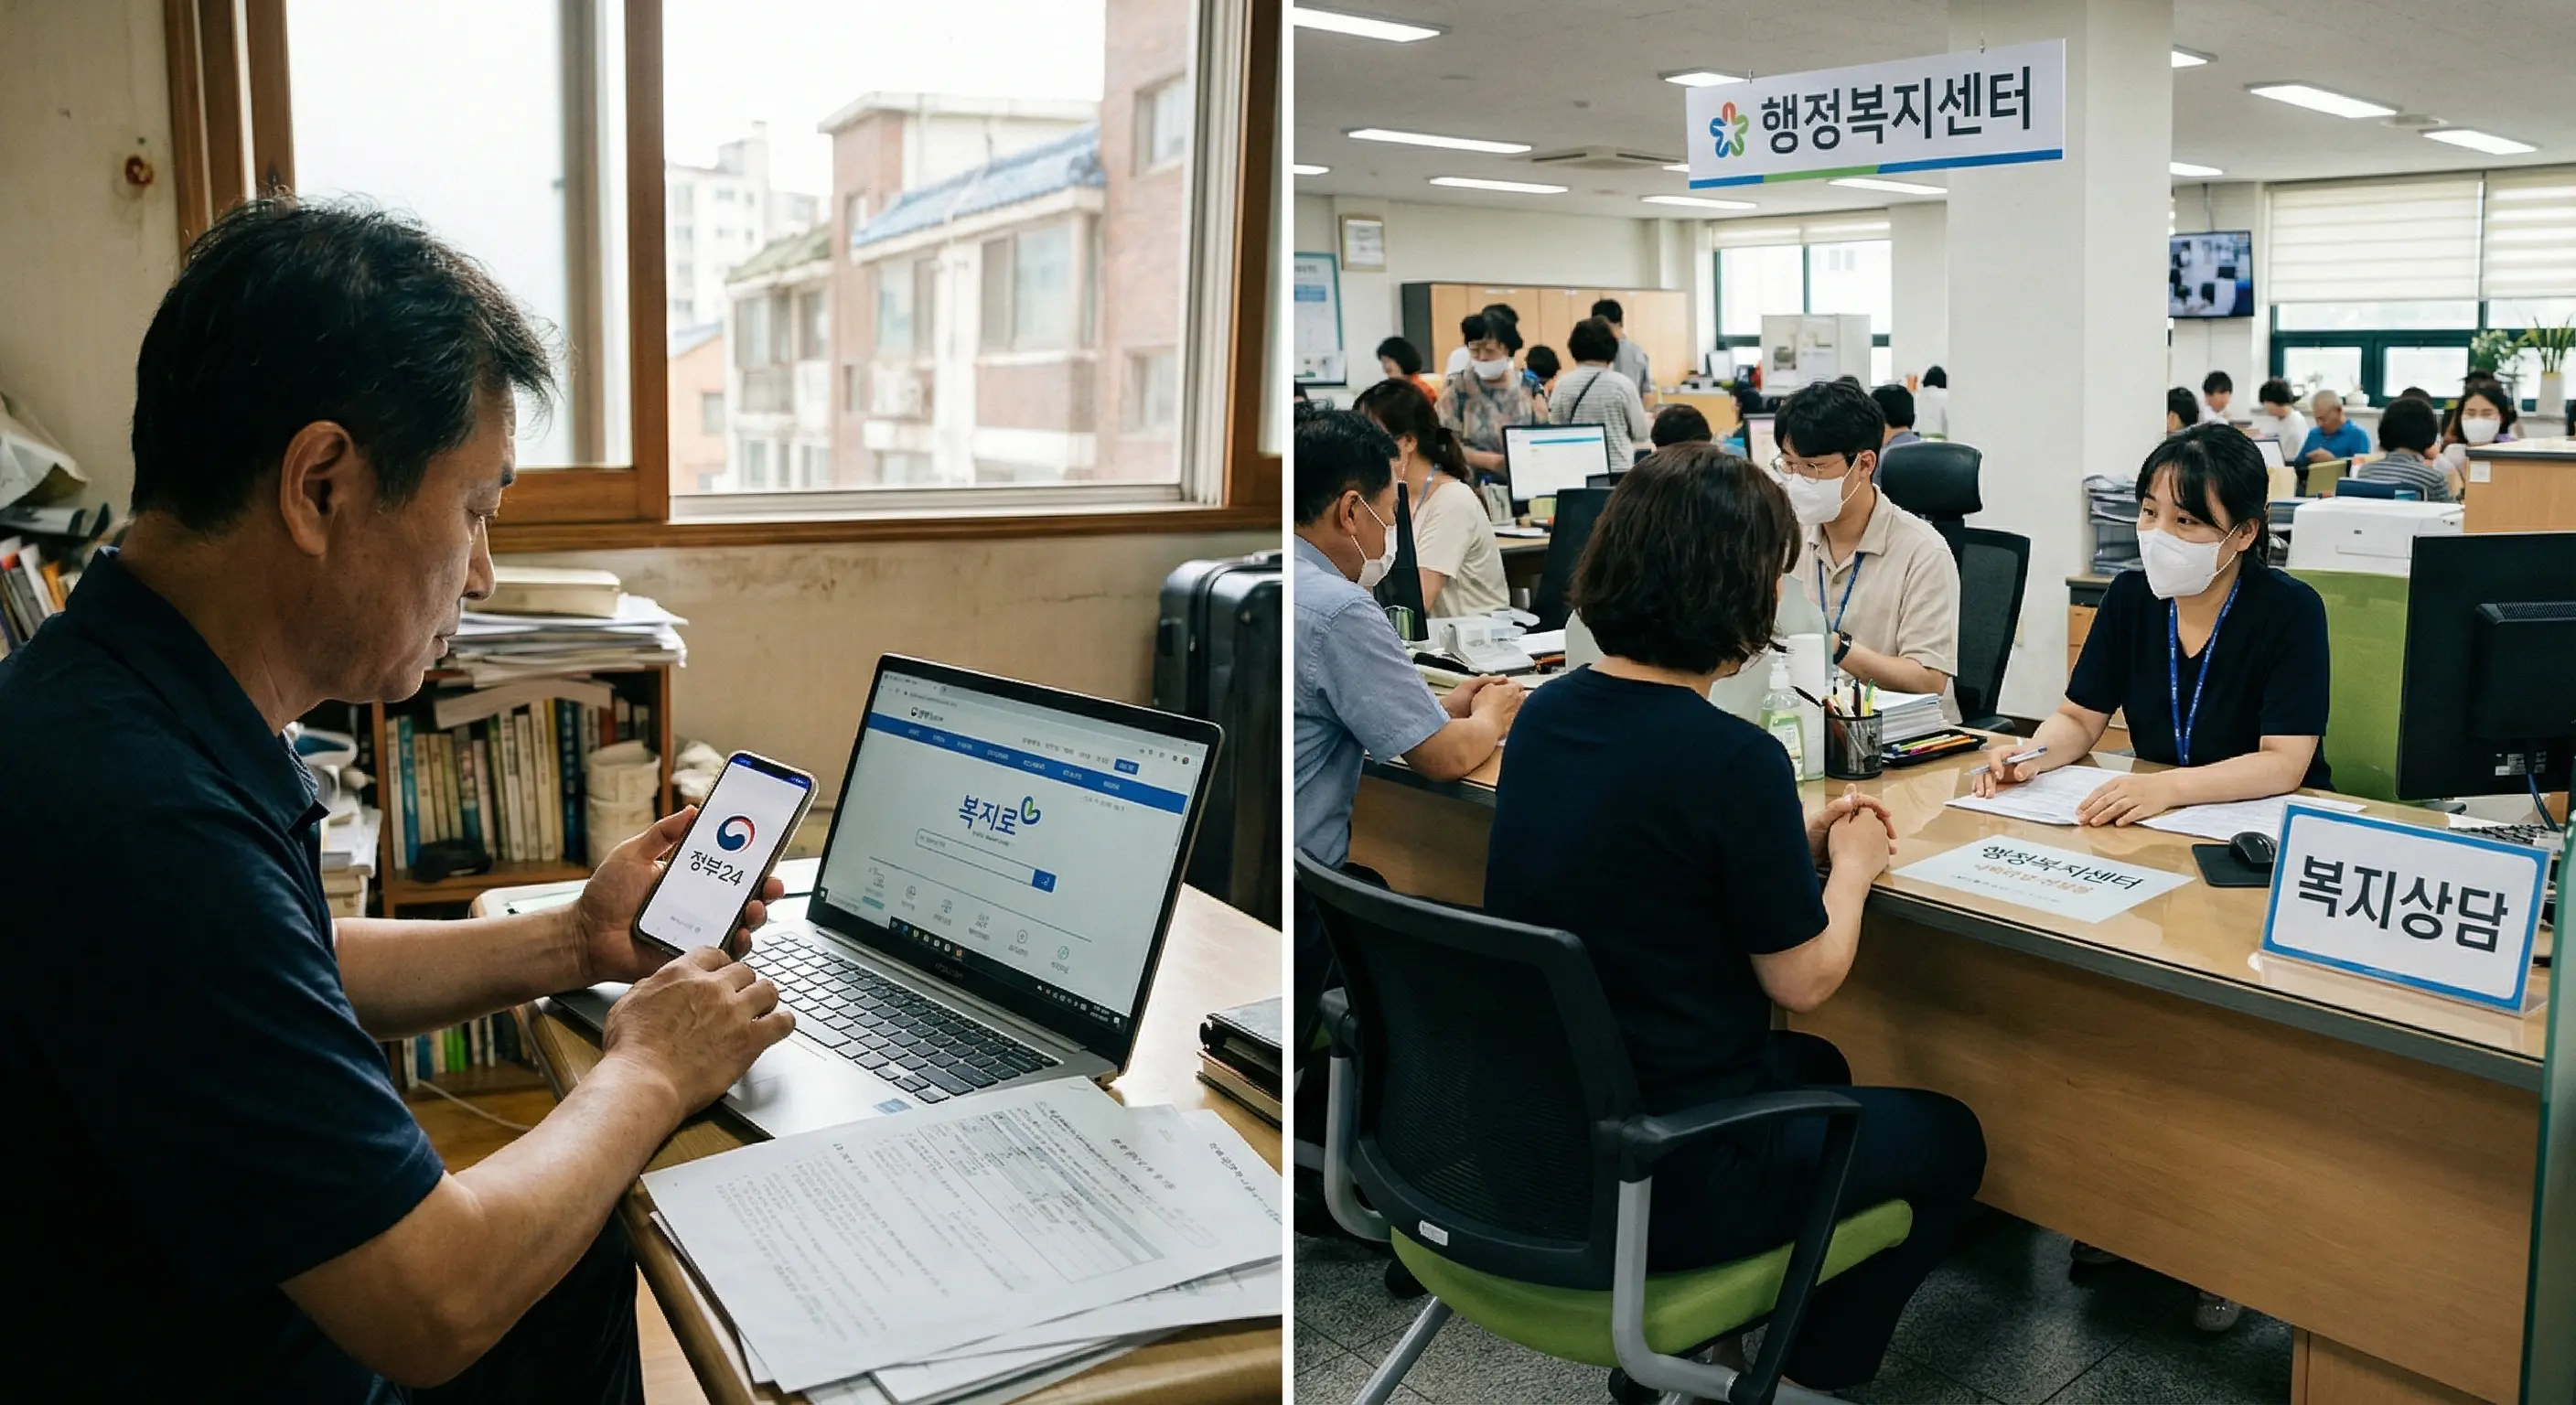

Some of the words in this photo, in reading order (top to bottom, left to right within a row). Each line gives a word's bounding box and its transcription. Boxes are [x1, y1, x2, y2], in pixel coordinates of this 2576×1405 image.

[1761, 66, 2031, 154] 행정복지센터
[959, 794, 1016, 835] 복지로
[690, 850, 744, 886] 정부24
[2298, 854, 2509, 953] 복지상담
